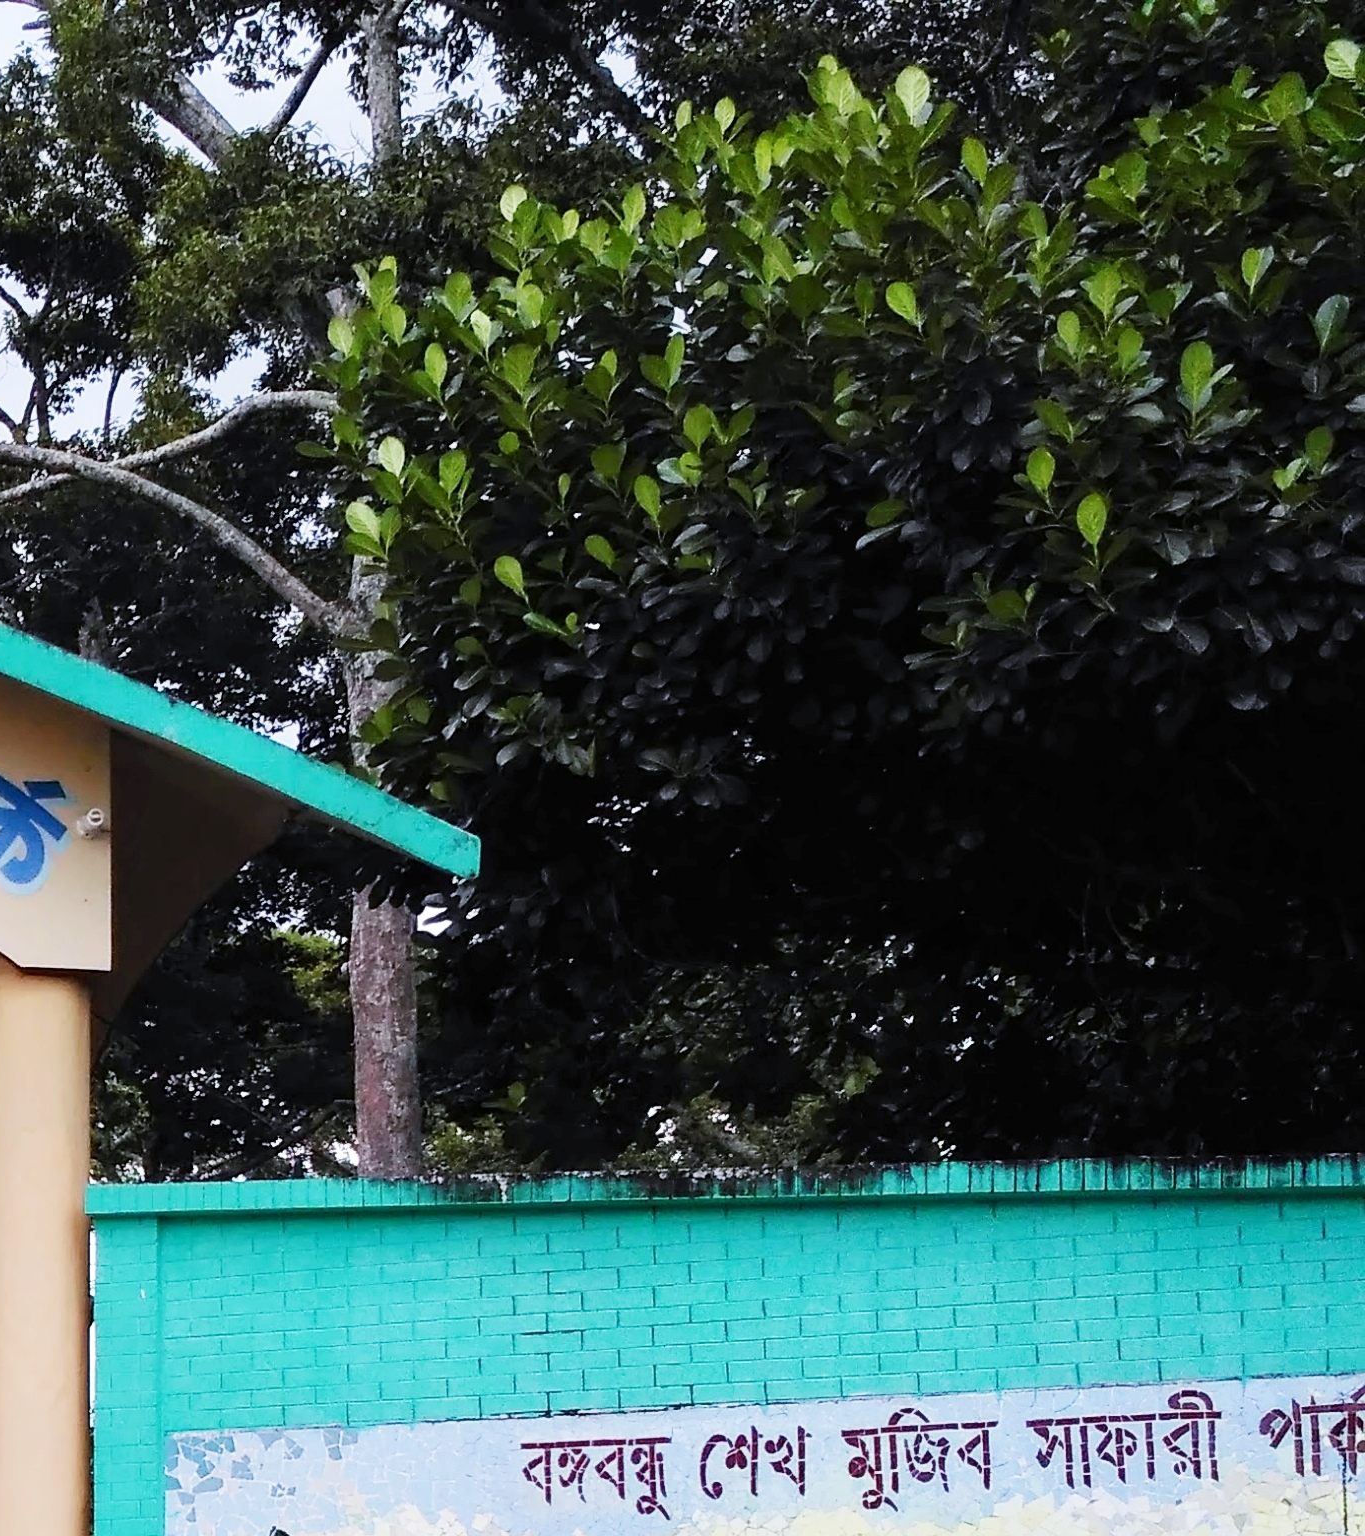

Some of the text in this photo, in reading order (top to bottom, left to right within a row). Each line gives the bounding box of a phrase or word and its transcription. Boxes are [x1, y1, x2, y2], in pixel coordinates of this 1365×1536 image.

[521, 1436, 673, 1521] বঙ্গবন্ধু
[700, 1424, 811, 1500] শেখ
[842, 1407, 998, 1511] মুজিব
[1026, 1390, 1223, 1488] সাফারী
